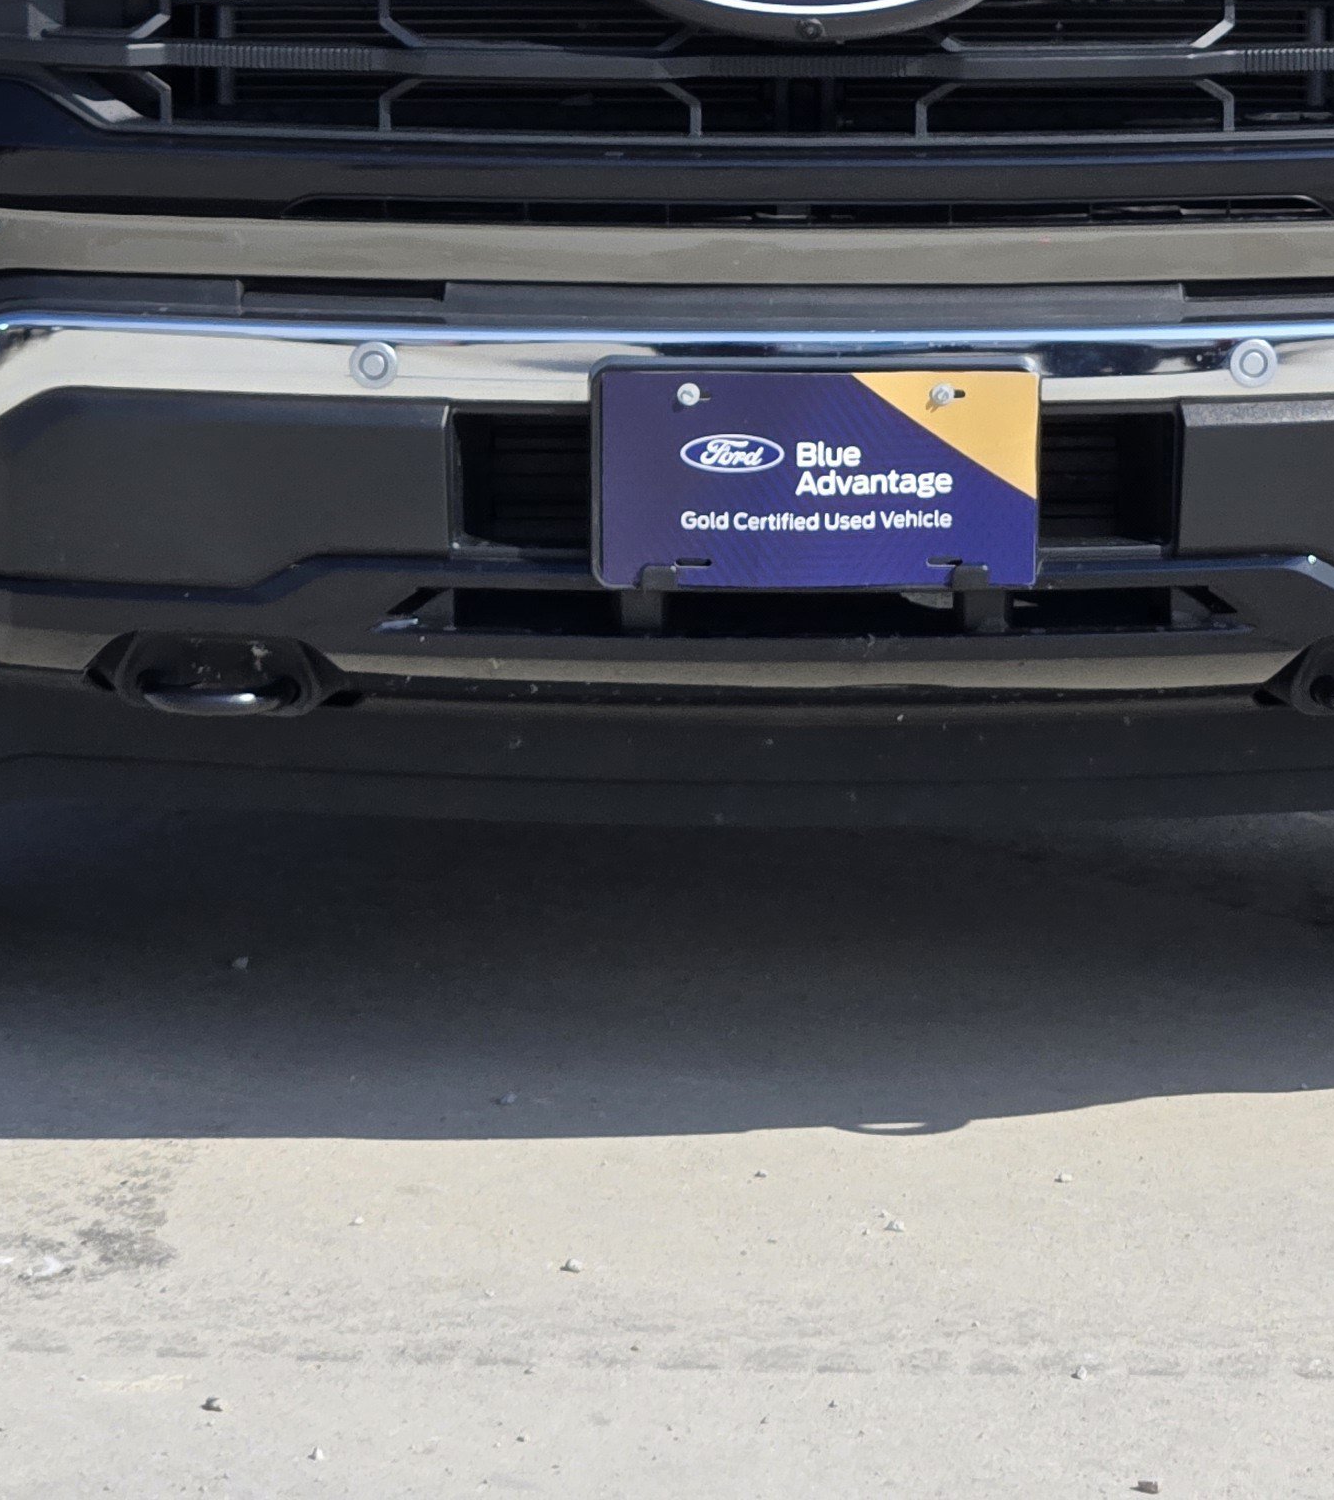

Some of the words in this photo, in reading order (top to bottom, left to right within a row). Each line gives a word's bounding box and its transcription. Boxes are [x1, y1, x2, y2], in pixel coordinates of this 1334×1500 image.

[700, 438, 765, 467] Ford
[795, 441, 861, 468] Blue
[794, 469, 953, 499] Advantage
[680, 510, 729, 531] Gold
[733, 510, 820, 531] Certified
[823, 511, 877, 531] Used
[880, 509, 954, 530] Vehicle
